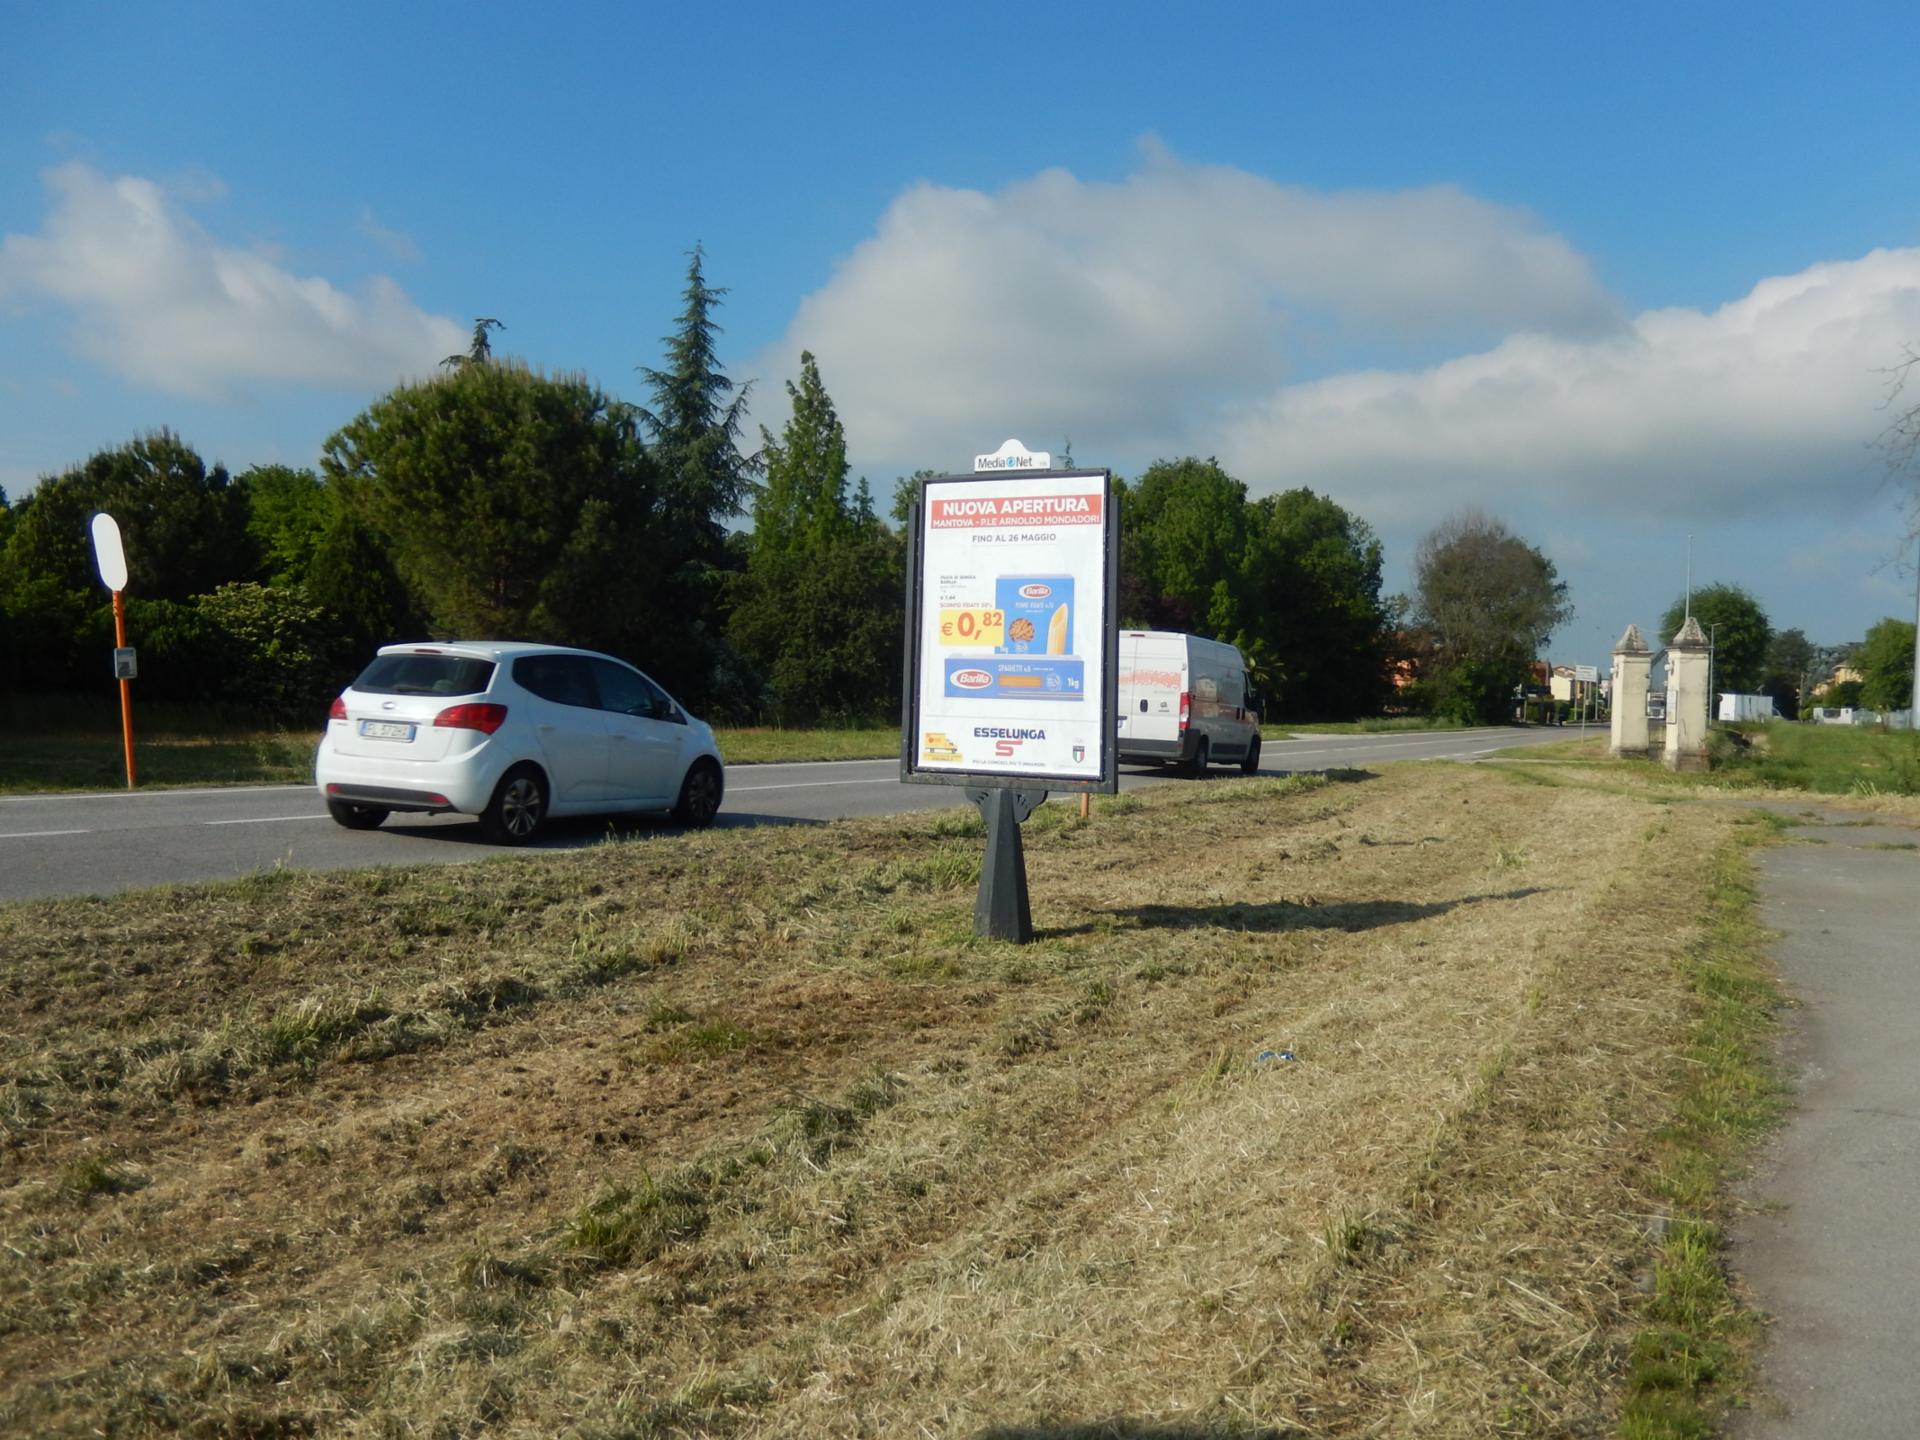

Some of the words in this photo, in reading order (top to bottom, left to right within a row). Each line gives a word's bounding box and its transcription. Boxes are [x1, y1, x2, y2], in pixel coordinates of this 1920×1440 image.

[978, 457, 1005, 468] Media
[1016, 456, 1032, 467] Net
[943, 501, 997, 516] NUOVA
[1000, 497, 1089, 514] APERTURA
[932, 519, 974, 528] MANTOVA
[999, 516, 1042, 526] ARNOLDO
[1043, 514, 1100, 524] MONDADORI
[972, 535, 993, 543] FINO
[995, 534, 1006, 543] AL
[1008, 534, 1019, 542] 26
[1021, 533, 1057, 542] MAGGIO
[941, 622, 953, 636] €
[960, 673, 990, 684] Barilla
[974, 727, 1046, 740] ESSELUNGA
